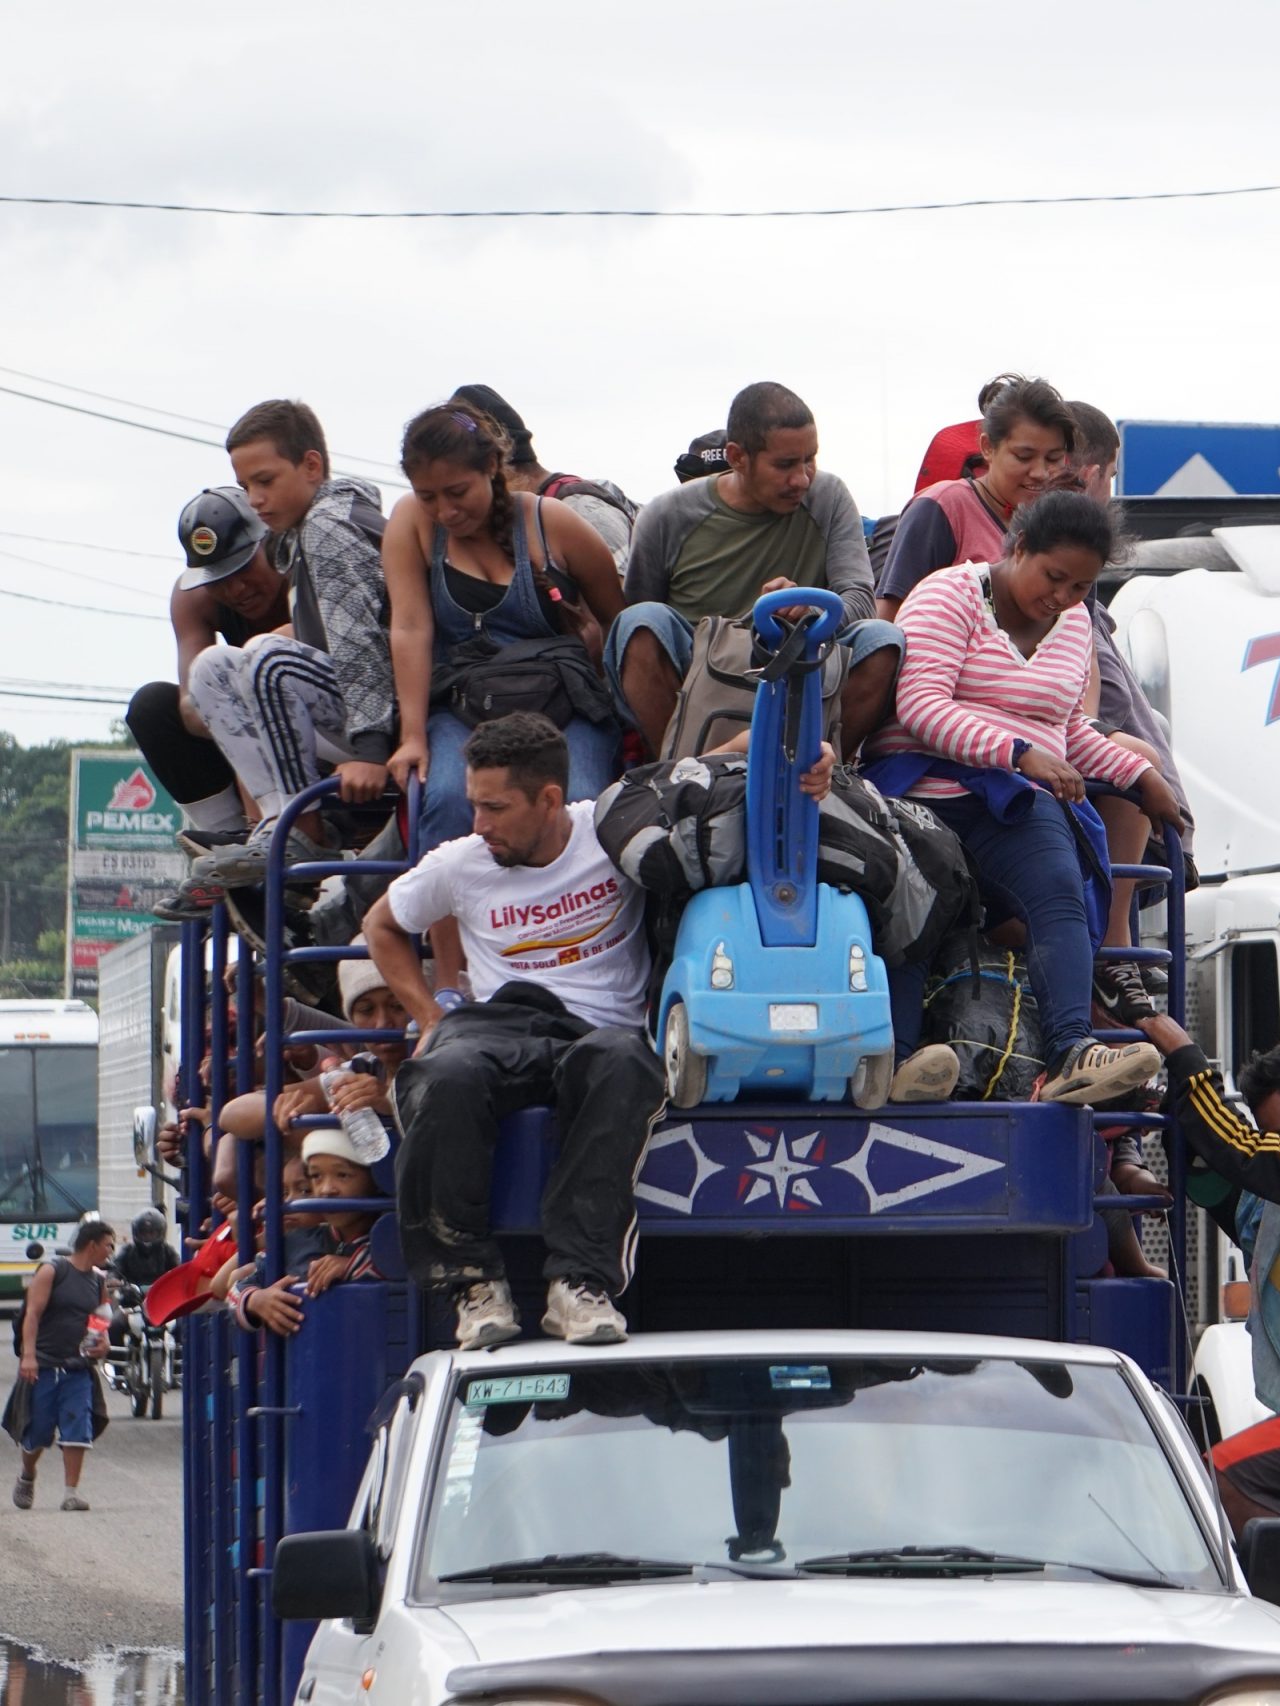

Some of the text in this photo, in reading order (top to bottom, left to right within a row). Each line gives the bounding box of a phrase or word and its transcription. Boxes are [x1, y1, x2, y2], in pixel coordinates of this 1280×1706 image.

[87, 811, 174, 832] PEMEX
[12, 1223, 58, 1240] SUR
[472, 1378, 567, 1400] XW-71-643
